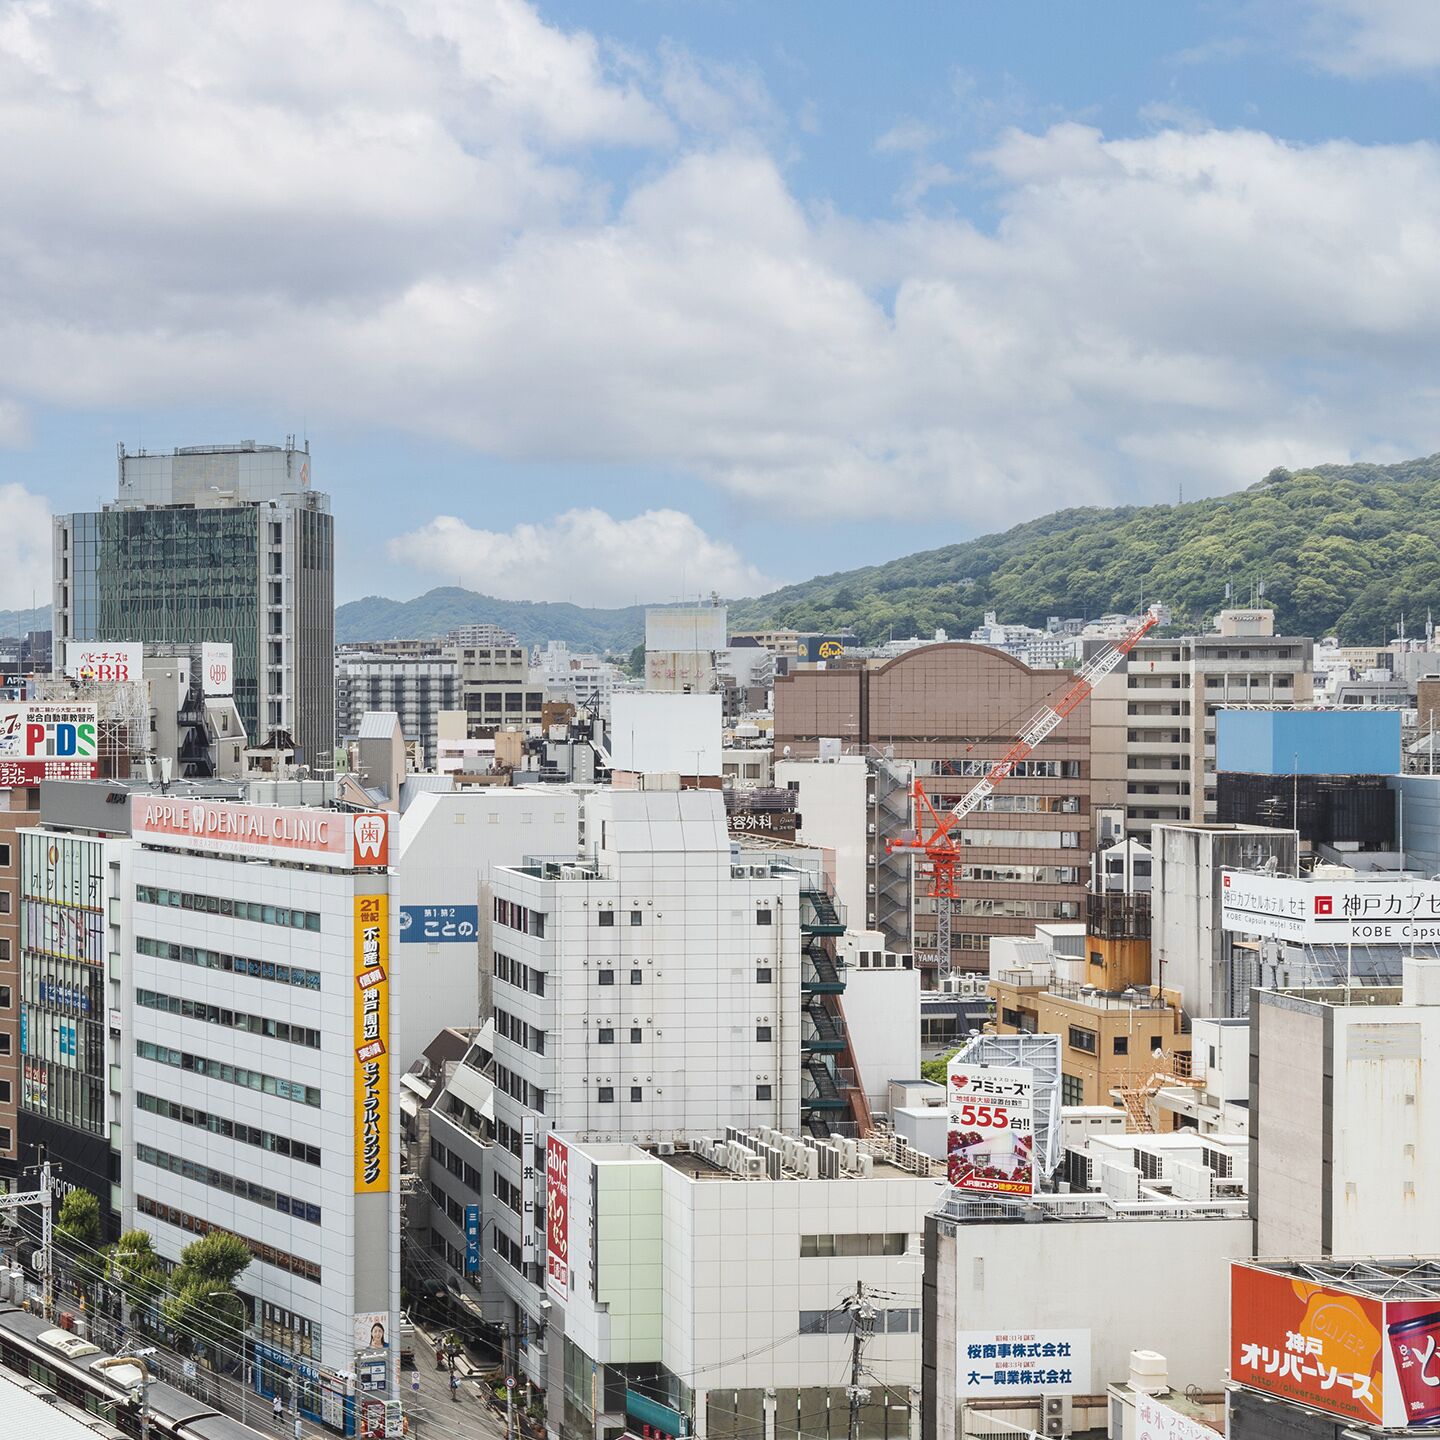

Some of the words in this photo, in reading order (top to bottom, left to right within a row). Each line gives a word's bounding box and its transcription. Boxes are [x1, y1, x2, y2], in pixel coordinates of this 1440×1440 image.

[80, 652, 128, 663] ベビーチーズは
[26, 714, 95, 723] 総合自動車教習所
[145, 805, 190, 829] APPLE
[208, 810, 269, 838] DENTAL
[272, 816, 329, 844] CLINIC
[359, 821, 380, 844] 歯
[360, 899, 380, 911] 21
[1224, 889, 1285, 912] 神戸カプセルホテル
[1289, 896, 1306, 916] セキ
[360, 912, 380, 922] 世紀
[1226, 912, 1242, 921] KOBE
[1245, 914, 1267, 926] Capsule
[424, 921, 478, 937] ことの
[1352, 926, 1392, 937] KOBE
[363, 927, 380, 967] 不動産
[359, 969, 384, 988] 信頼
[363, 989, 380, 1040] 神戸周辺
[358, 1042, 383, 1061] 実績
[971, 1080, 1030, 1095] アミューズ
[363, 1062, 380, 1184] セントラルハウジング
[524, 1133, 534, 1247] 三共ビル
[1285, 1330, 1323, 1356] 神戸
[1314, 1313, 1366, 1357] OLIVER
[967, 1342, 1071, 1359] 桜商事株式会社
[967, 1368, 1072, 1385] 大一興業株式会社
[1241, 1343, 1374, 1404] オリバーソース
